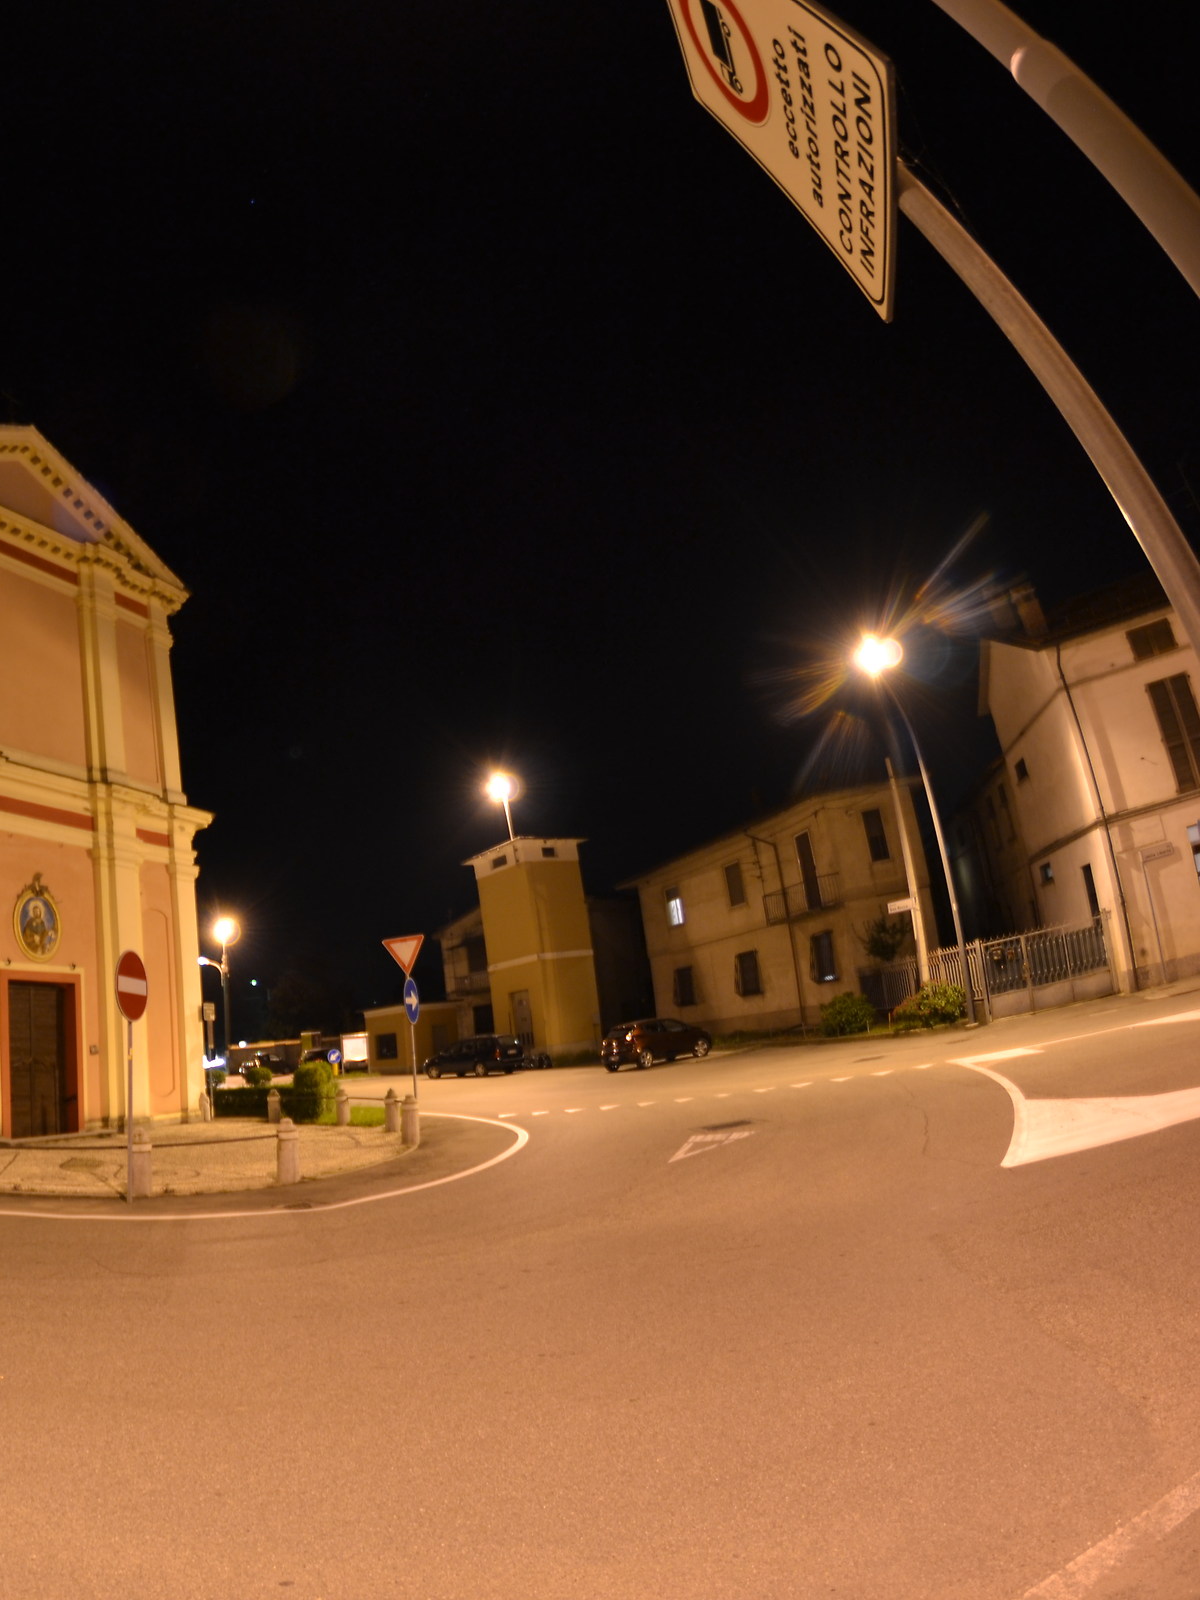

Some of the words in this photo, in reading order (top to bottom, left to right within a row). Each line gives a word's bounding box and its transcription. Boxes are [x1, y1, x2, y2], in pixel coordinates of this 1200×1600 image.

[772, 38, 800, 159] eccetto
[788, 25, 824, 208] autorizzati
[851, 70, 875, 279] INFRAZIONI
